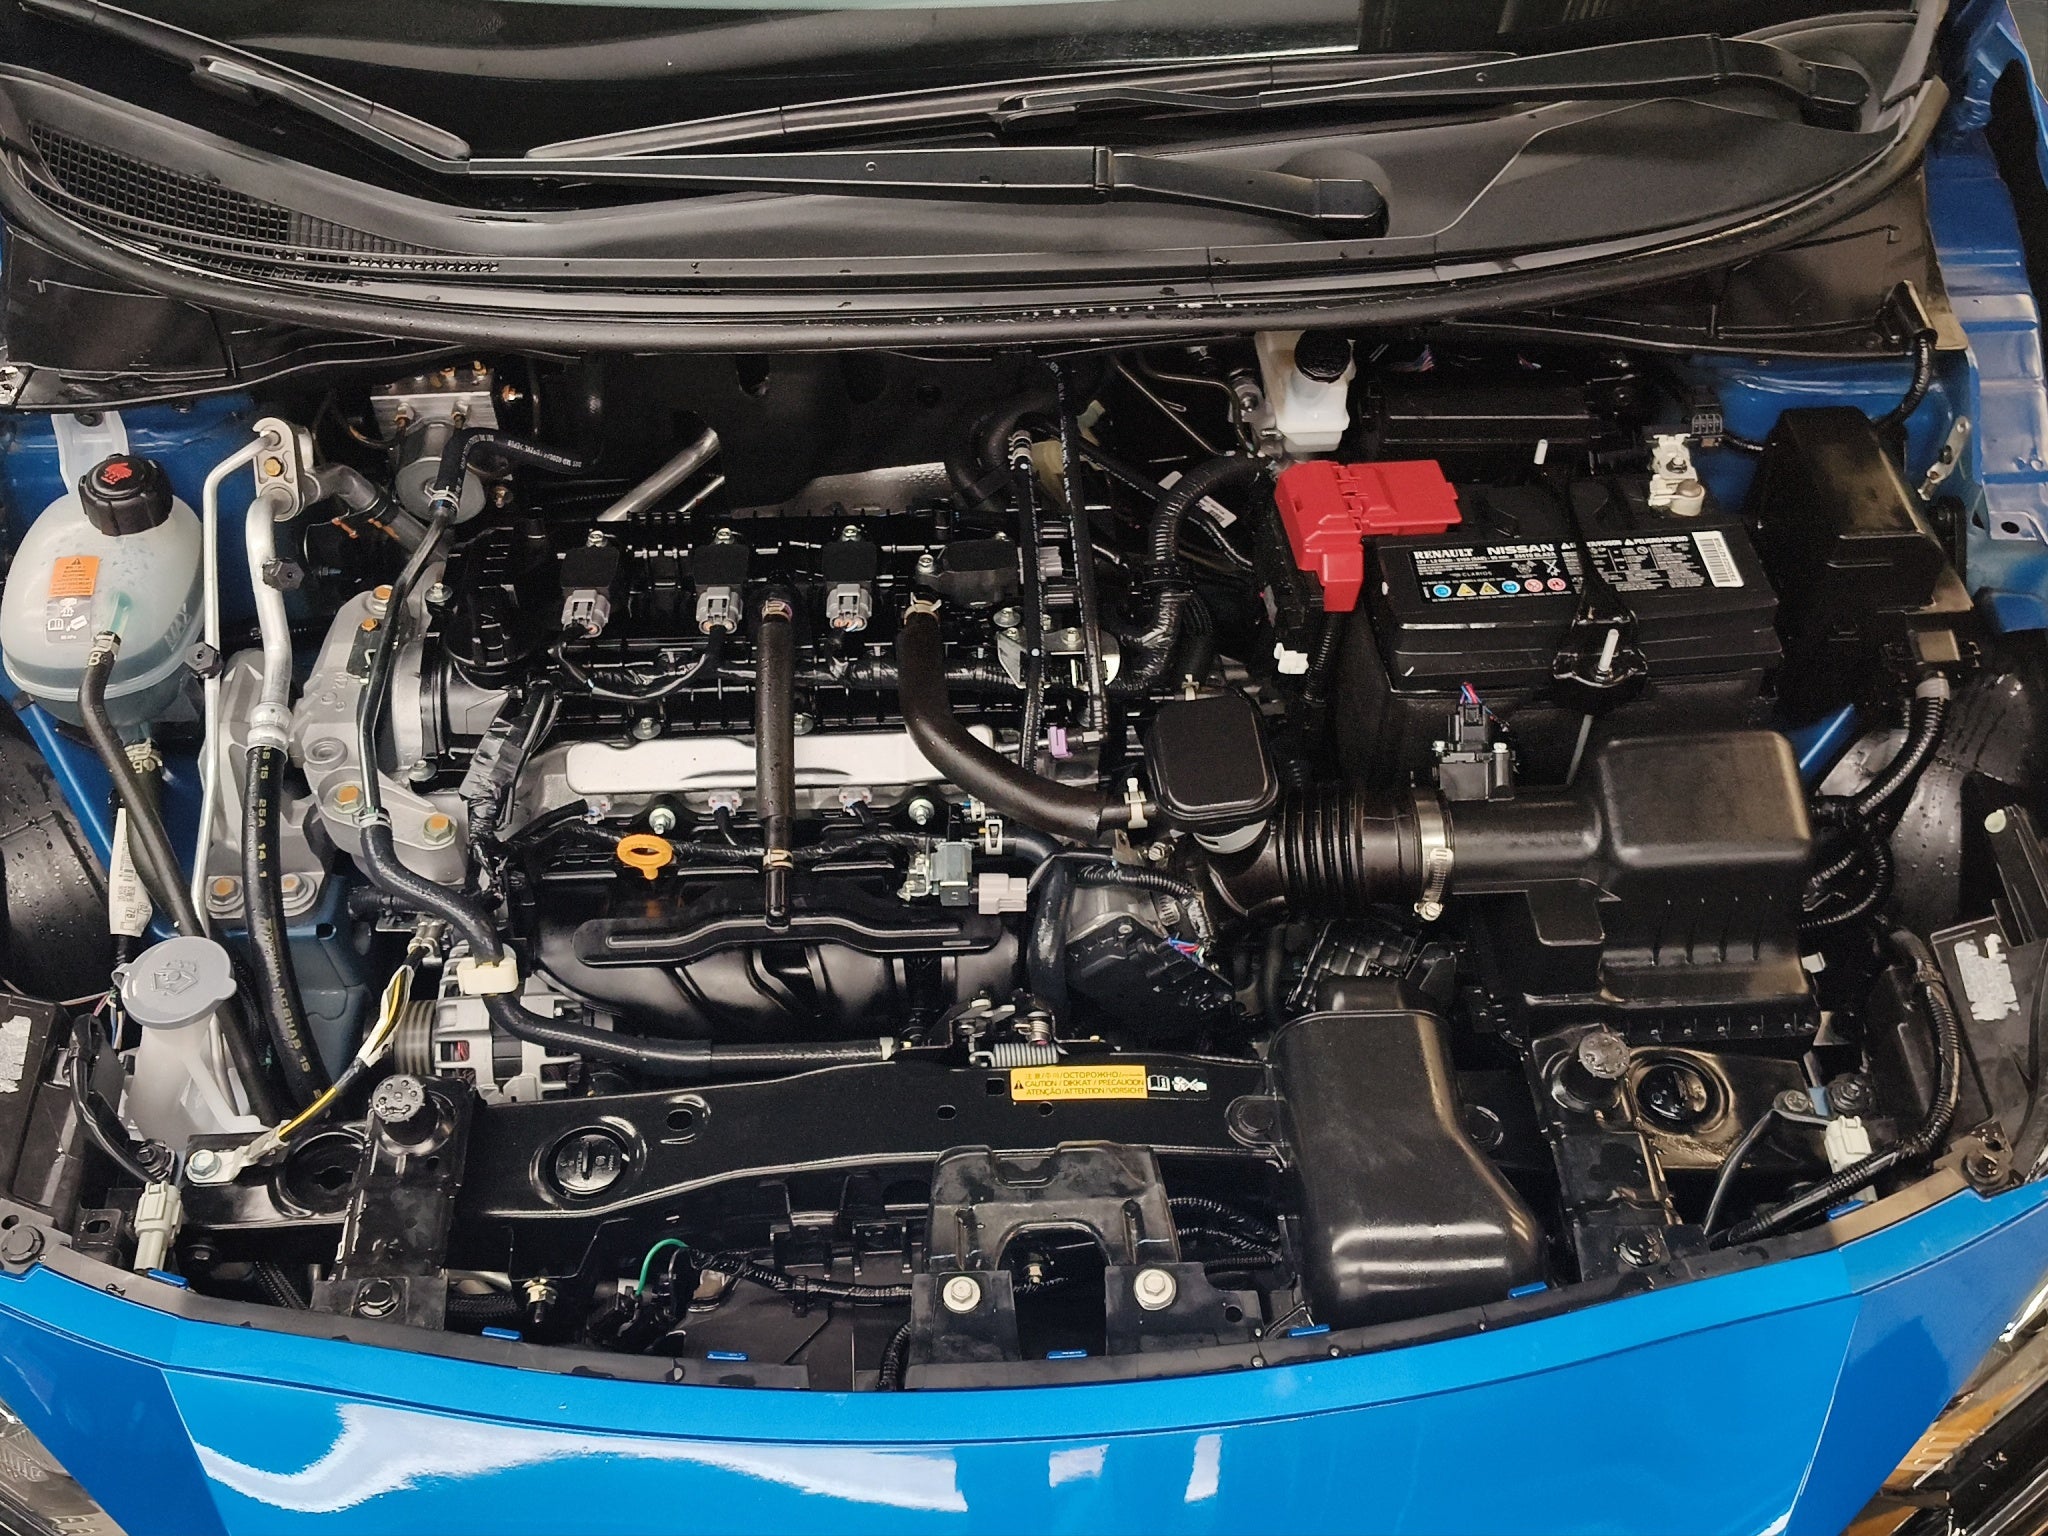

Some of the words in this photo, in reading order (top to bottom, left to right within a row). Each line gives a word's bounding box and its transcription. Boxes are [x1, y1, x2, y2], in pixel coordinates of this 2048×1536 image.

[1413, 548, 1474, 560] RENAULT
[1486, 543, 1555, 556] NISSAN
[258, 799, 267, 828] 25A
